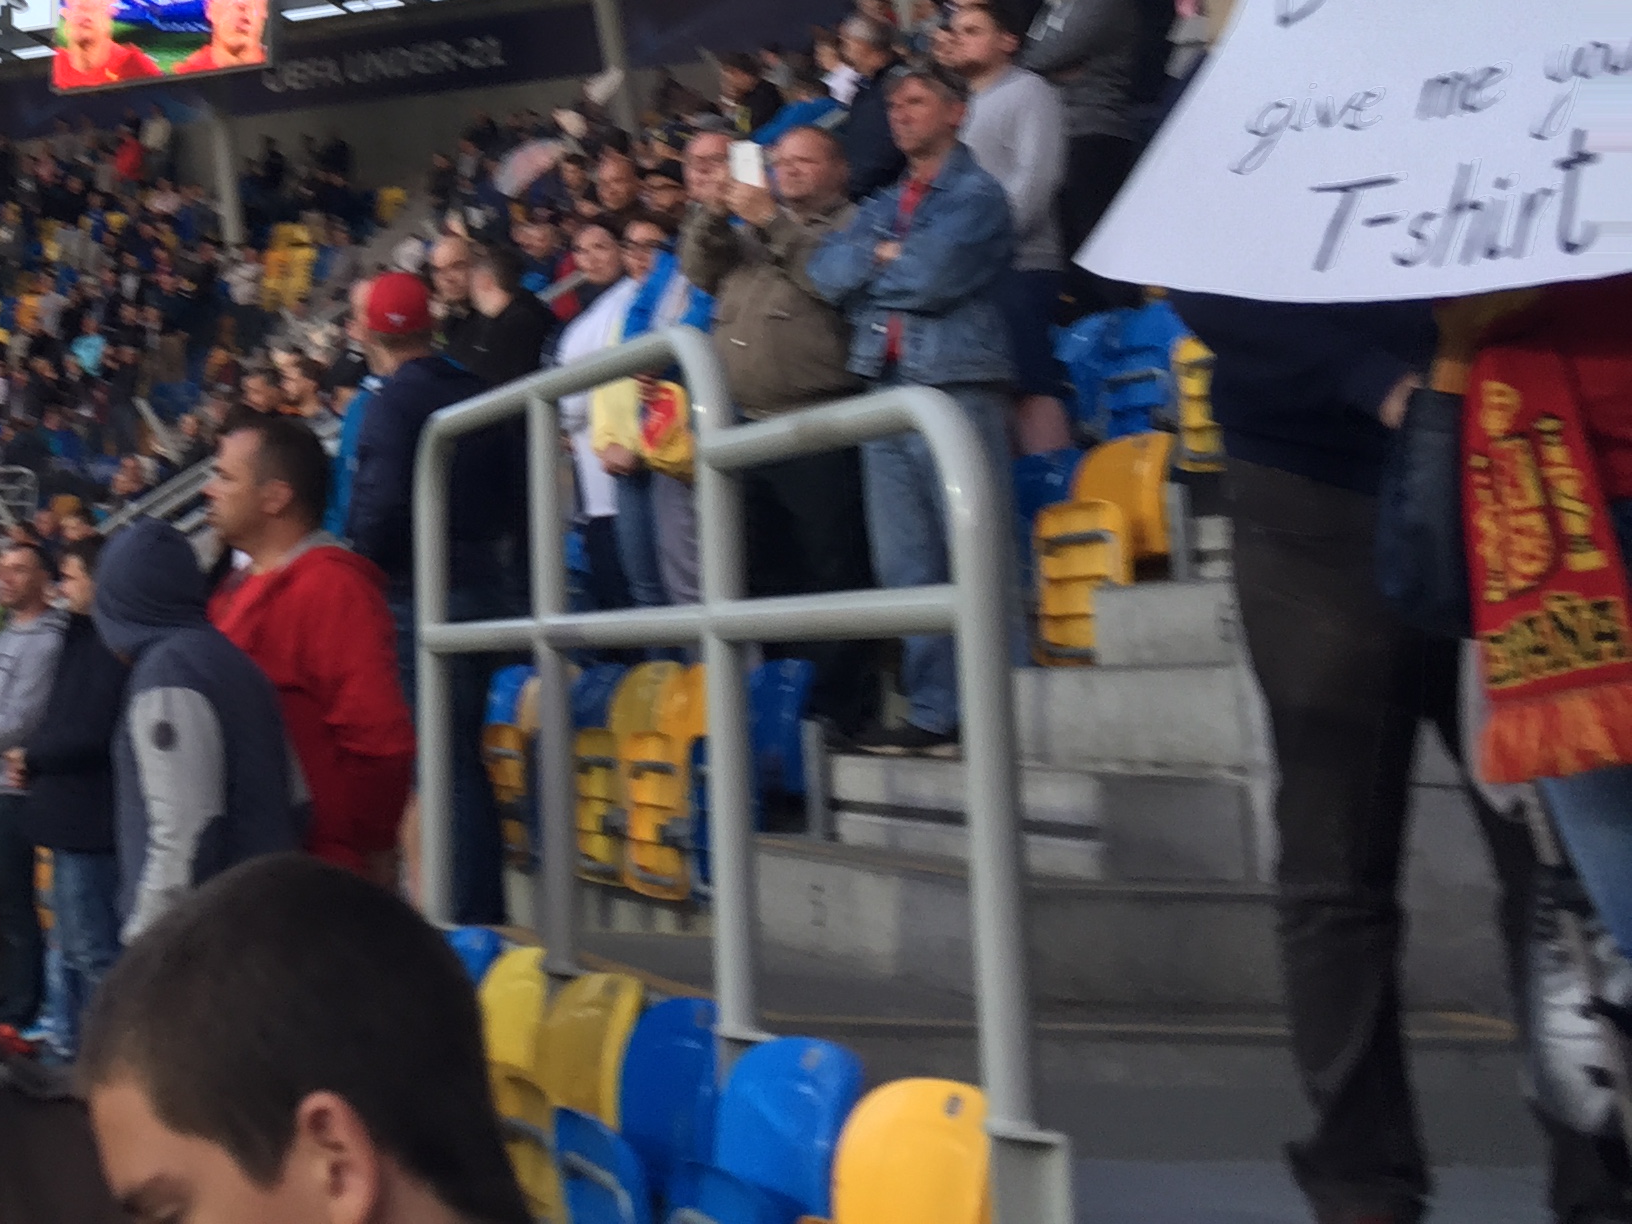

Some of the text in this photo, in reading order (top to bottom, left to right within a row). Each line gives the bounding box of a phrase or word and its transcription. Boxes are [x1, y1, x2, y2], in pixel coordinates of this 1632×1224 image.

[1229, 82, 1386, 175] give
[1415, 60, 1513, 120] me
[1309, 128, 1601, 272] T-shirt
